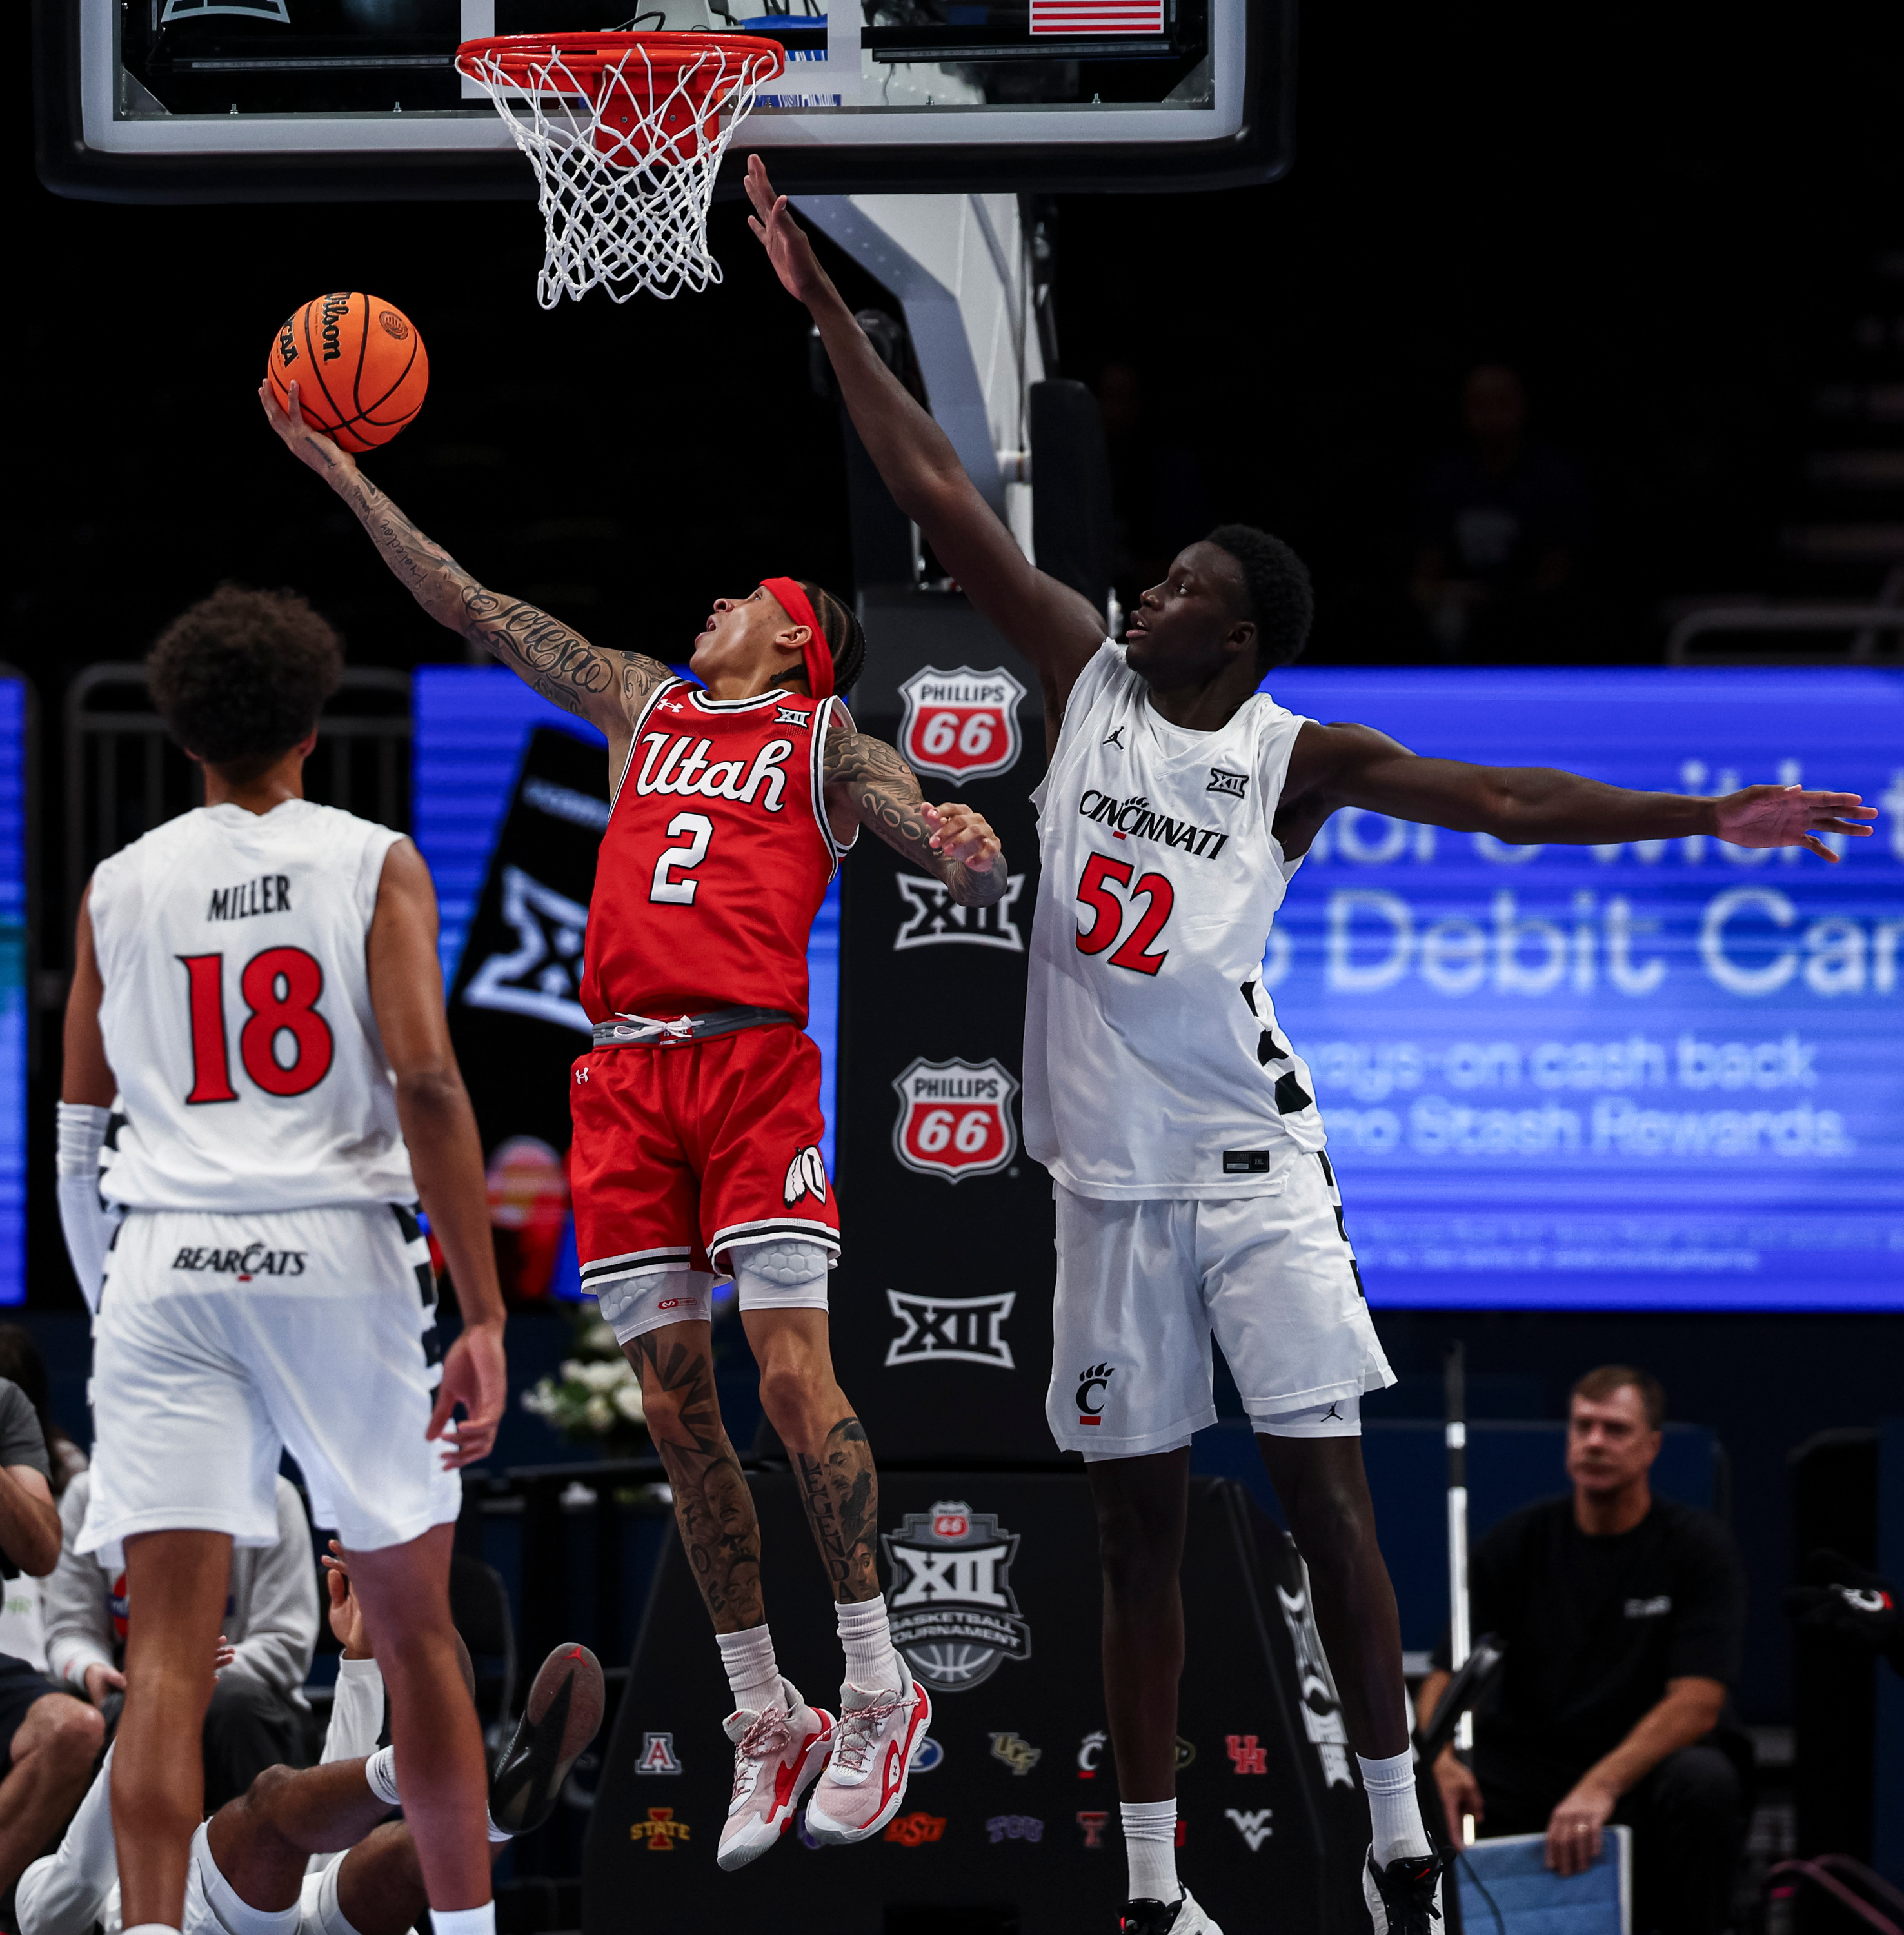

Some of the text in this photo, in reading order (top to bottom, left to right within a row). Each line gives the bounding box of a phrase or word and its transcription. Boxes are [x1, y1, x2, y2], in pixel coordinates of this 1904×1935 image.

[920, 684, 1005, 703] PHILLIPS
[773, 706, 812, 728] XII
[922, 711, 997, 756] 66
[636, 731, 795, 813] Utah
[1206, 768, 1250, 799] XII
[1079, 788, 1230, 860] CINCINNATI
[648, 811, 715, 907] 2
[207, 875, 292, 922] MILLER
[1075, 851, 1175, 977] 52
[1325, 886, 1668, 997] Debit
[174, 945, 335, 1105] 18
[1530, 1031, 1668, 1091] cash
[1678, 1031, 1820, 1091] back
[914, 1077, 1000, 1099] PHILLIPS
[917, 1109, 993, 1154] 66
[172, 1244, 308, 1277] BEARCATS
[884, 1289, 1017, 1369] XII
[891, 1544, 1009, 1608] XII
[891, 1624, 1021, 1648] OURNAMENT
[635, 1732, 682, 1775] A
[988, 1732, 1042, 1776] UCF
[631, 1821, 691, 1841] STATE
[986, 1814, 1044, 1844] TCU
